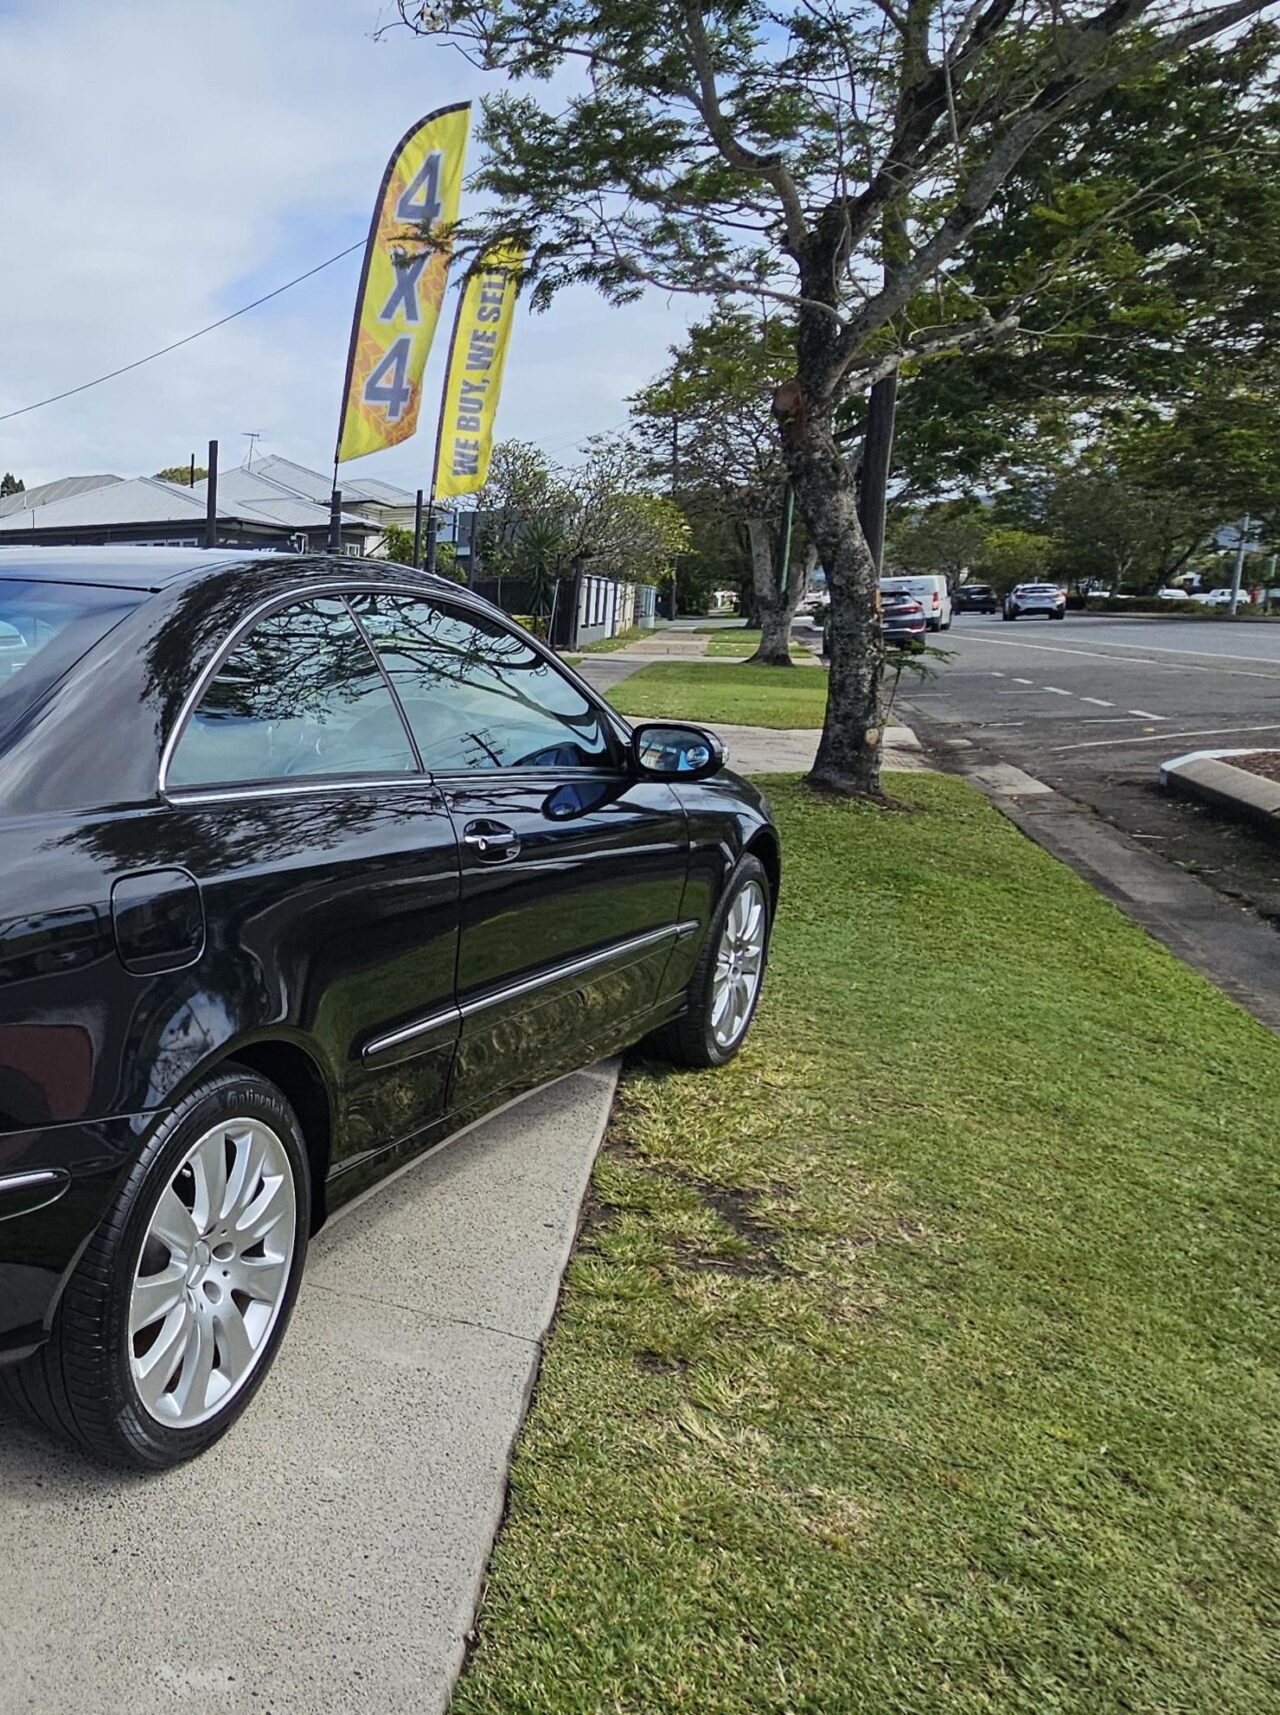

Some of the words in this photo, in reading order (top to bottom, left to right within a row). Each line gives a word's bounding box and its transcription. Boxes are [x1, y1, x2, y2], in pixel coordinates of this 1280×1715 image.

[466, 329, 497, 371] WE
[456, 379, 490, 432] BUY,
[453, 438, 480, 476] WE
